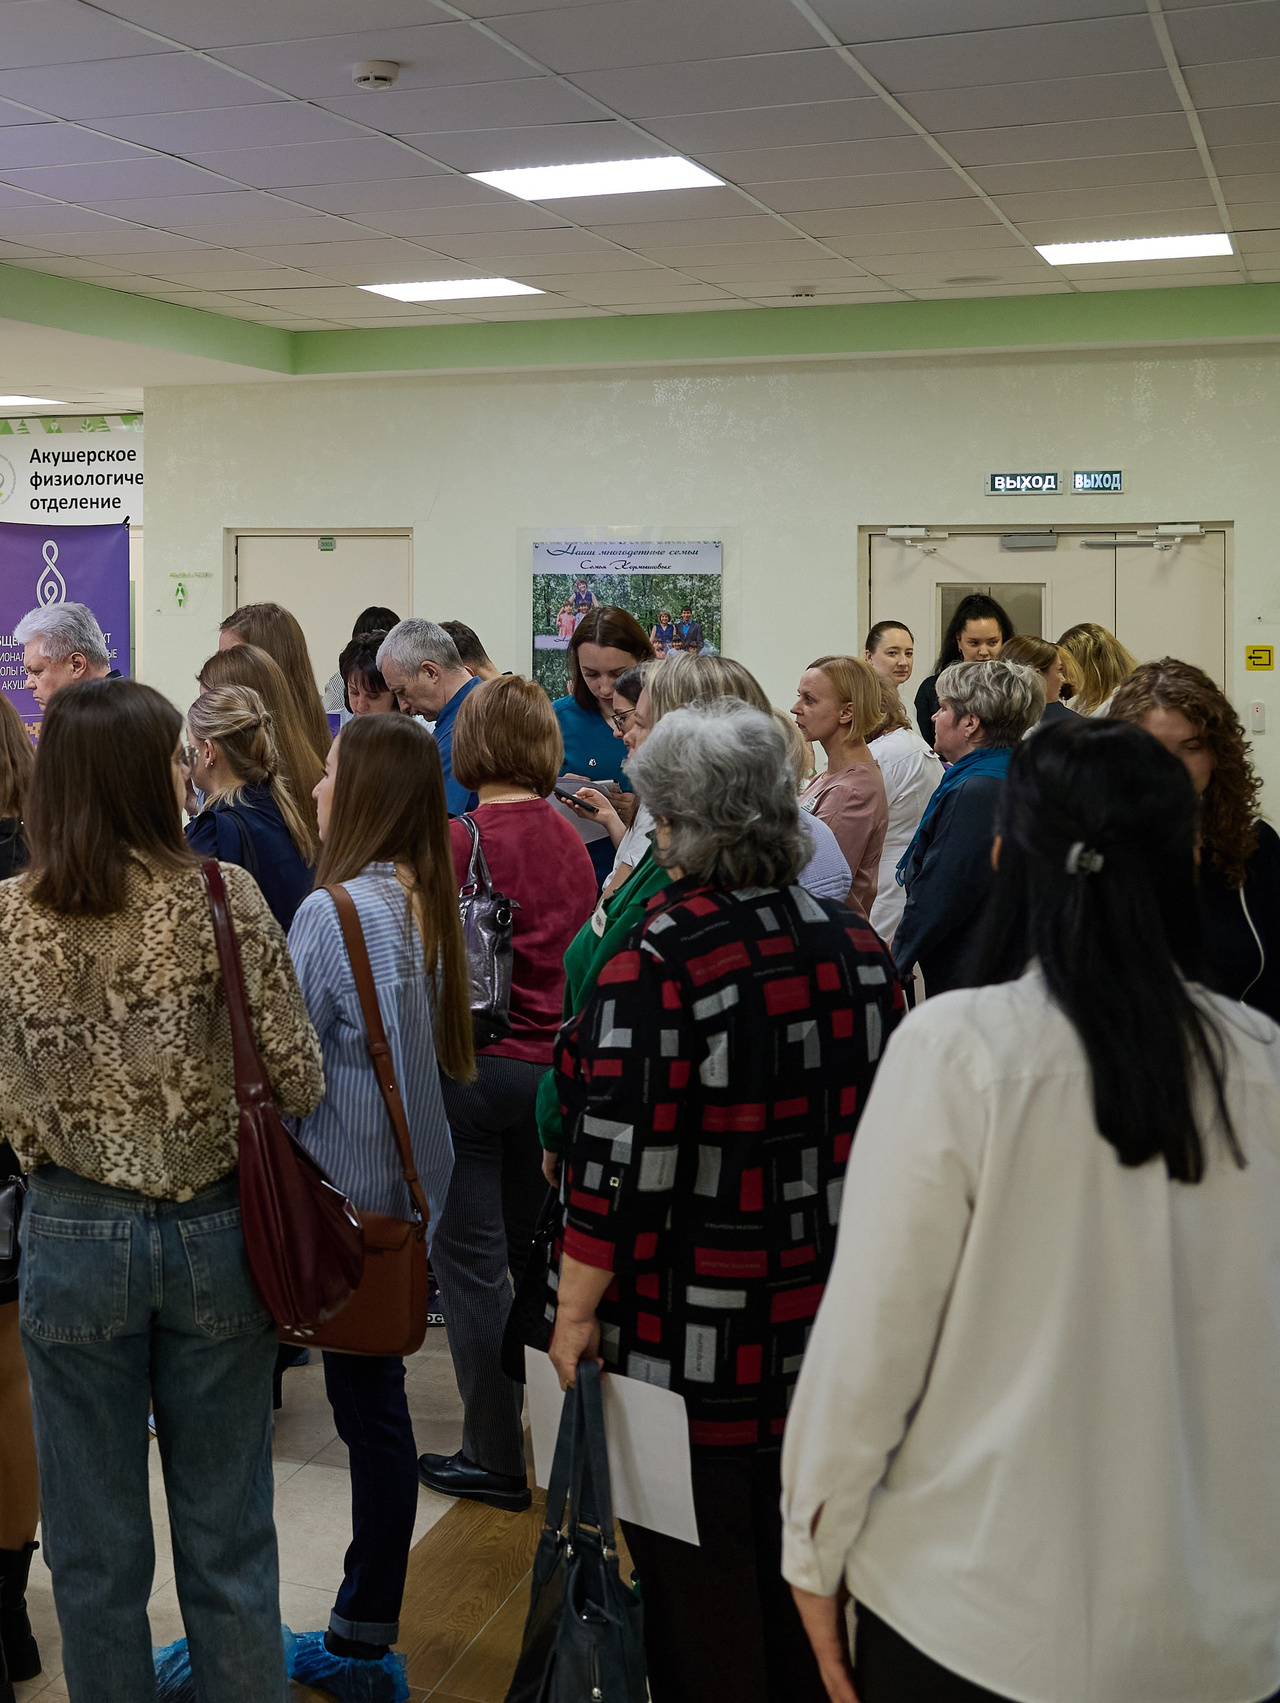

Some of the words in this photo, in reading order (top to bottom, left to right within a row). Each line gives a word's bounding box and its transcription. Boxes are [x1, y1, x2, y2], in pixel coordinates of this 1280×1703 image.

[29, 448, 137, 467] Акушерское
[994, 475, 1056, 489] ВЫХОД
[1075, 474, 1121, 490] ВЫХОД
[29, 496, 122, 512] отделение
[546, 543, 596, 557] Наши
